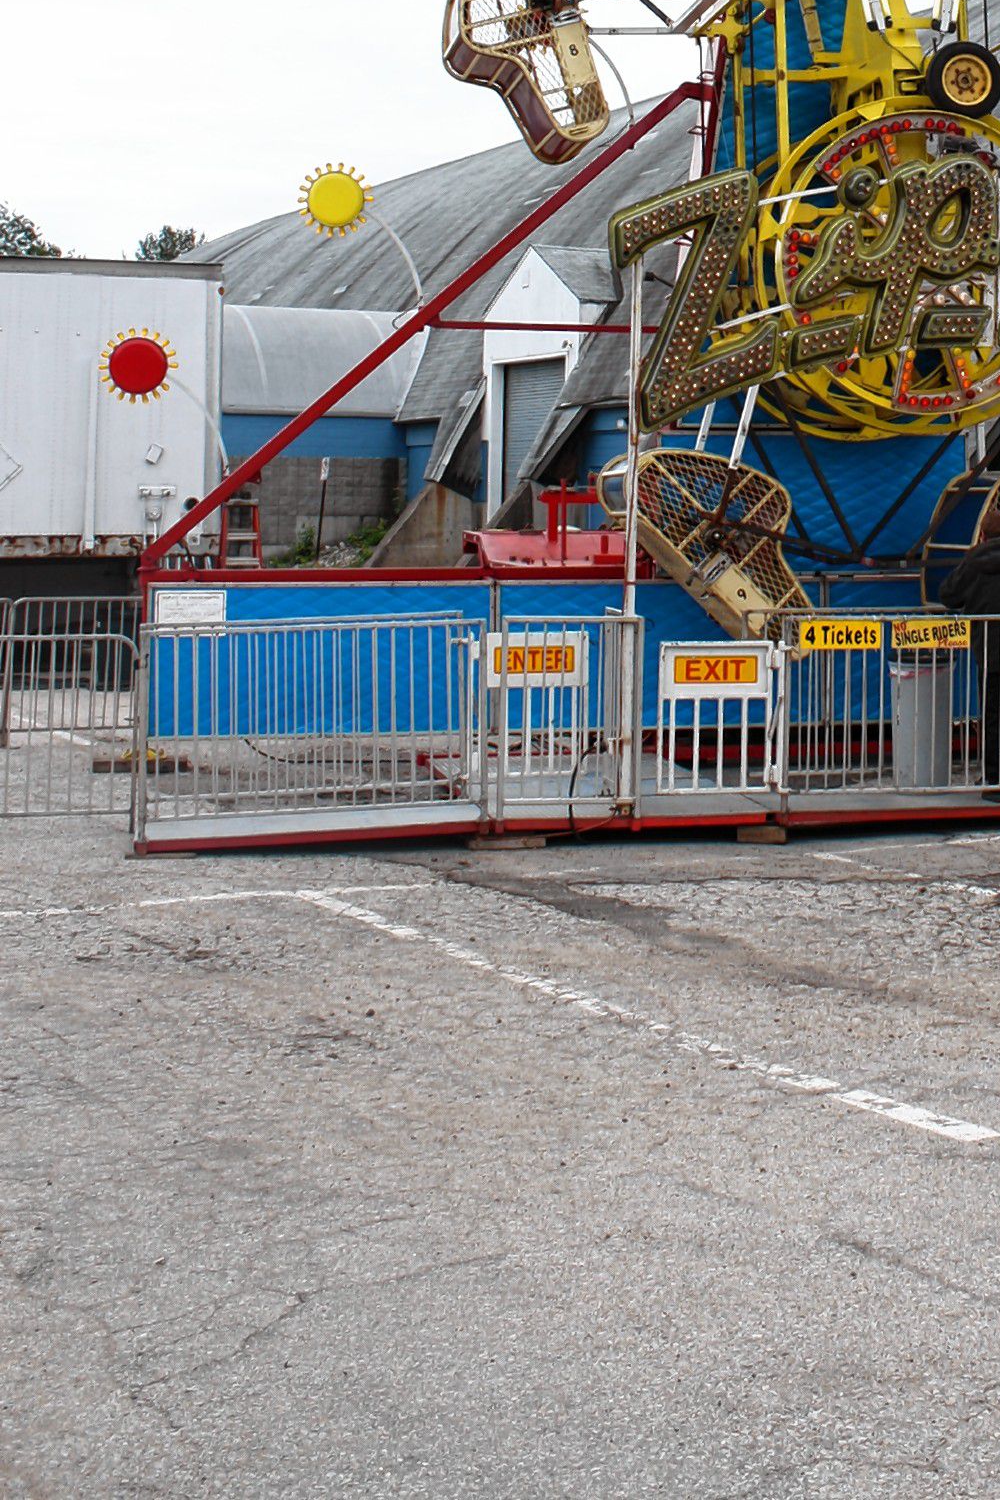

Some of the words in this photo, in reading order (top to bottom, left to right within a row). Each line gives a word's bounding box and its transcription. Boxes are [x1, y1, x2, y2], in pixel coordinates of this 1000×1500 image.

[568, 43, 580, 57] 8
[736, 588, 747, 601] 9
[893, 622, 907, 633] NO
[895, 627, 931, 647] SINGLE
[932, 622, 967, 642] RIDERS
[805, 625, 816, 645] 4
[821, 625, 877, 645] Tickets
[938, 638, 968, 648] Please
[685, 659, 747, 681] EXIT
